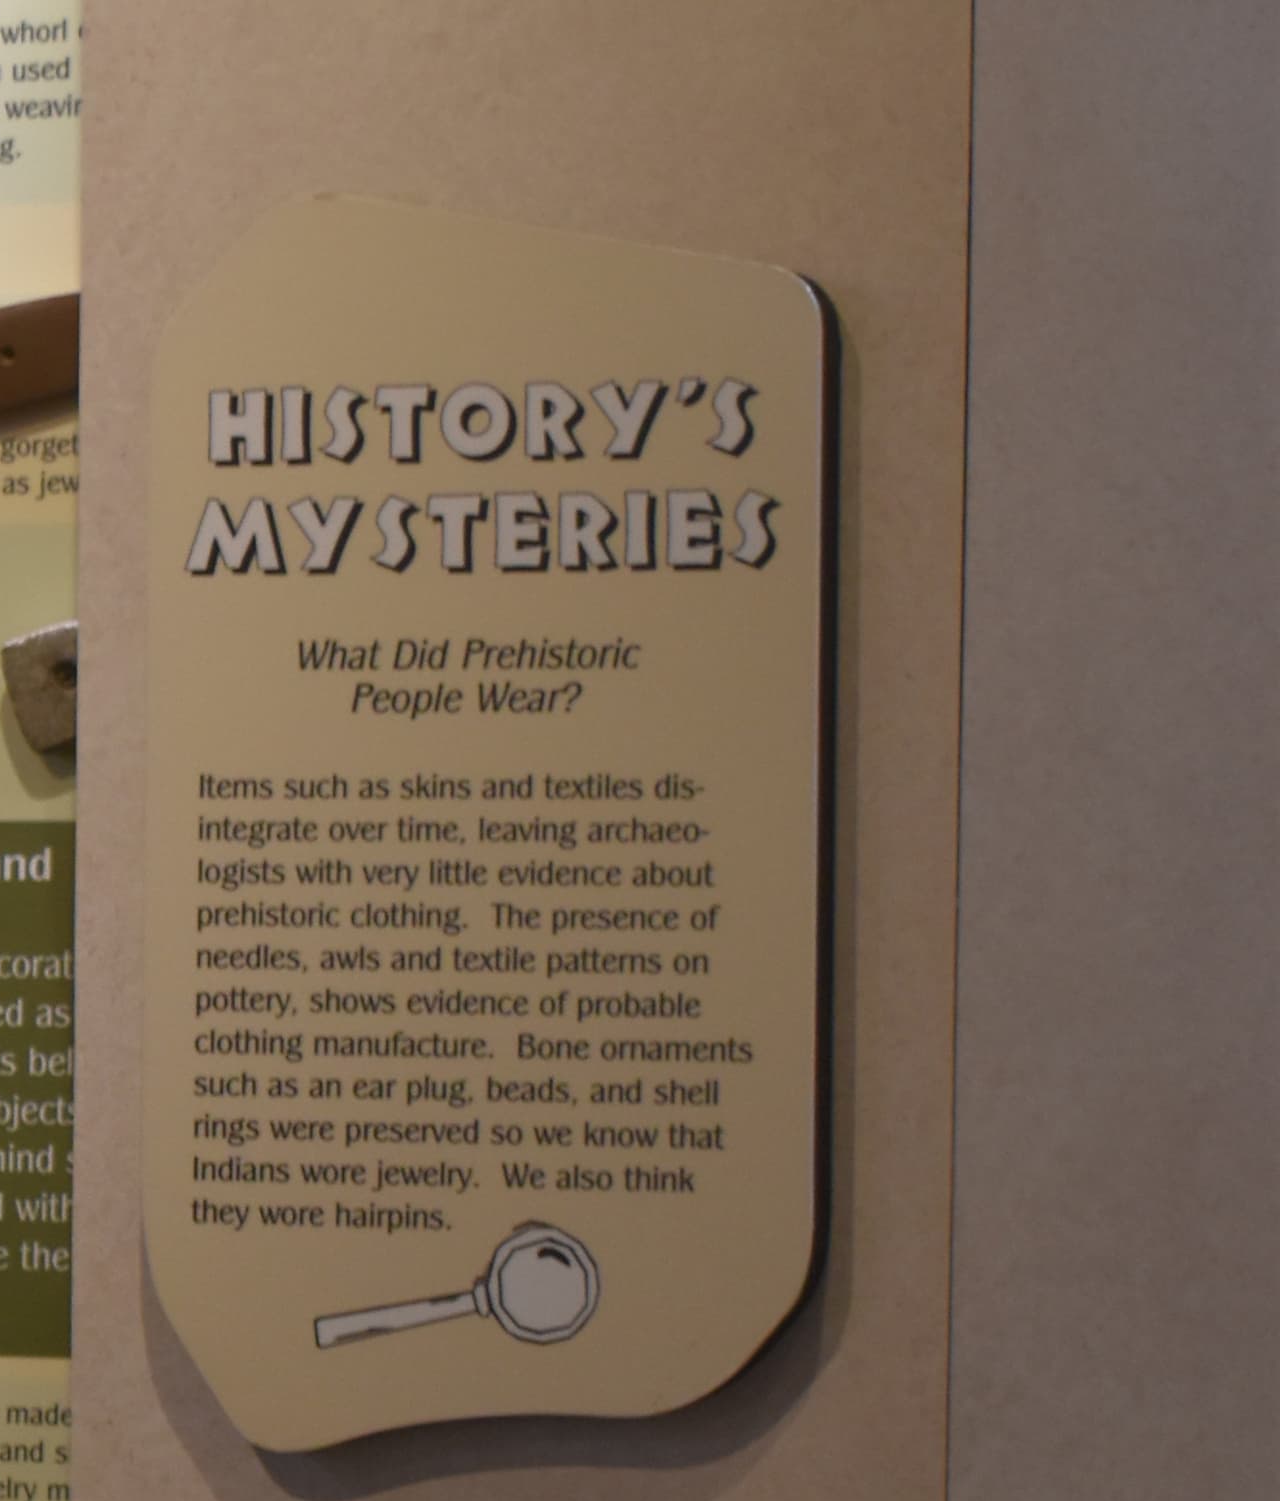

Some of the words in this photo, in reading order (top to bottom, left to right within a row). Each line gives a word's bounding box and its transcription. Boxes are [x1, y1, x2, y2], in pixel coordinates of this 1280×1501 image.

[0, 18, 68, 45] whorl
[12, 57, 70, 82] used
[208, 376, 759, 467] HISTORY'S
[3, 476, 29, 495] as
[35, 471, 79, 501] jew
[183, 487, 781, 576] MYSTERIES
[296, 638, 381, 671] What
[393, 638, 448, 671] Did
[462, 637, 641, 671] Prehistoric
[350, 681, 463, 718] People
[476, 680, 583, 714] Wear?
[198, 774, 274, 800] Items
[283, 774, 348, 800] such
[360, 779, 390, 800] as
[400, 775, 472, 800] skins
[481, 775, 534, 800] and
[544, 774, 643, 800] textiles
[655, 775, 706, 800] dis-
[198, 816, 318, 848] integrate
[329, 823, 388, 844] over
[397, 818, 467, 846] time,
[478, 817, 577, 849] leaving
[587, 819, 710, 845] archaeo-
[197, 859, 286, 892] logists
[296, 860, 352, 886] with
[362, 866, 419, 893] very
[428, 861, 487, 887] little
[498, 862, 622, 888] evidence
[631, 862, 715, 889] about
[196, 902, 340, 932] prehistoric
[350, 904, 469, 935] clothing.
[491, 905, 541, 931] The
[551, 909, 679, 936] presence
[691, 905, 721, 932] of
[196, 946, 308, 975] needles,
[319, 947, 381, 973] awls
[391, 947, 442, 973] and
[453, 948, 536, 975] textile
[546, 950, 662, 979] patterns
[673, 953, 710, 976] on
[35, 1004, 70, 1028] as
[194, 992, 299, 1018] pottery,
[309, 990, 397, 1015] shows
[406, 991, 529, 1017] evidence
[540, 991, 570, 1017] of
[577, 992, 702, 1022] probable
[194, 1030, 303, 1062] clothing
[313, 1033, 495, 1060] manufacture.
[517, 1034, 590, 1061] Bone
[600, 1037, 754, 1064] ornaments
[194, 1074, 258, 1098] such
[268, 1078, 298, 1098] as
[310, 1078, 343, 1098] an
[353, 1079, 396, 1100] ear
[406, 1077, 473, 1107] plug,
[486, 1078, 578, 1106] beads,
[590, 1079, 642, 1105] and
[654, 1079, 720, 1107] shell
[193, 1116, 260, 1146] rings
[270, 1122, 335, 1142] were
[345, 1121, 480, 1147] preserved
[490, 1125, 523, 1145] so
[534, 1126, 573, 1146] we
[584, 1122, 659, 1148] know
[669, 1123, 725, 1151] that
[192, 1158, 291, 1185] Indians
[301, 1164, 367, 1186] wore
[373, 1162, 480, 1194] jewelry.
[502, 1163, 547, 1189] We
[556, 1165, 613, 1191] also
[624, 1166, 696, 1193] think
[192, 1201, 249, 1230] they
[259, 1206, 325, 1227] wore
[335, 1203, 453, 1235] hairpins.
[20, 1244, 68, 1272] the
[7, 1403, 72, 1427] made
[0, 1440, 43, 1463] and
